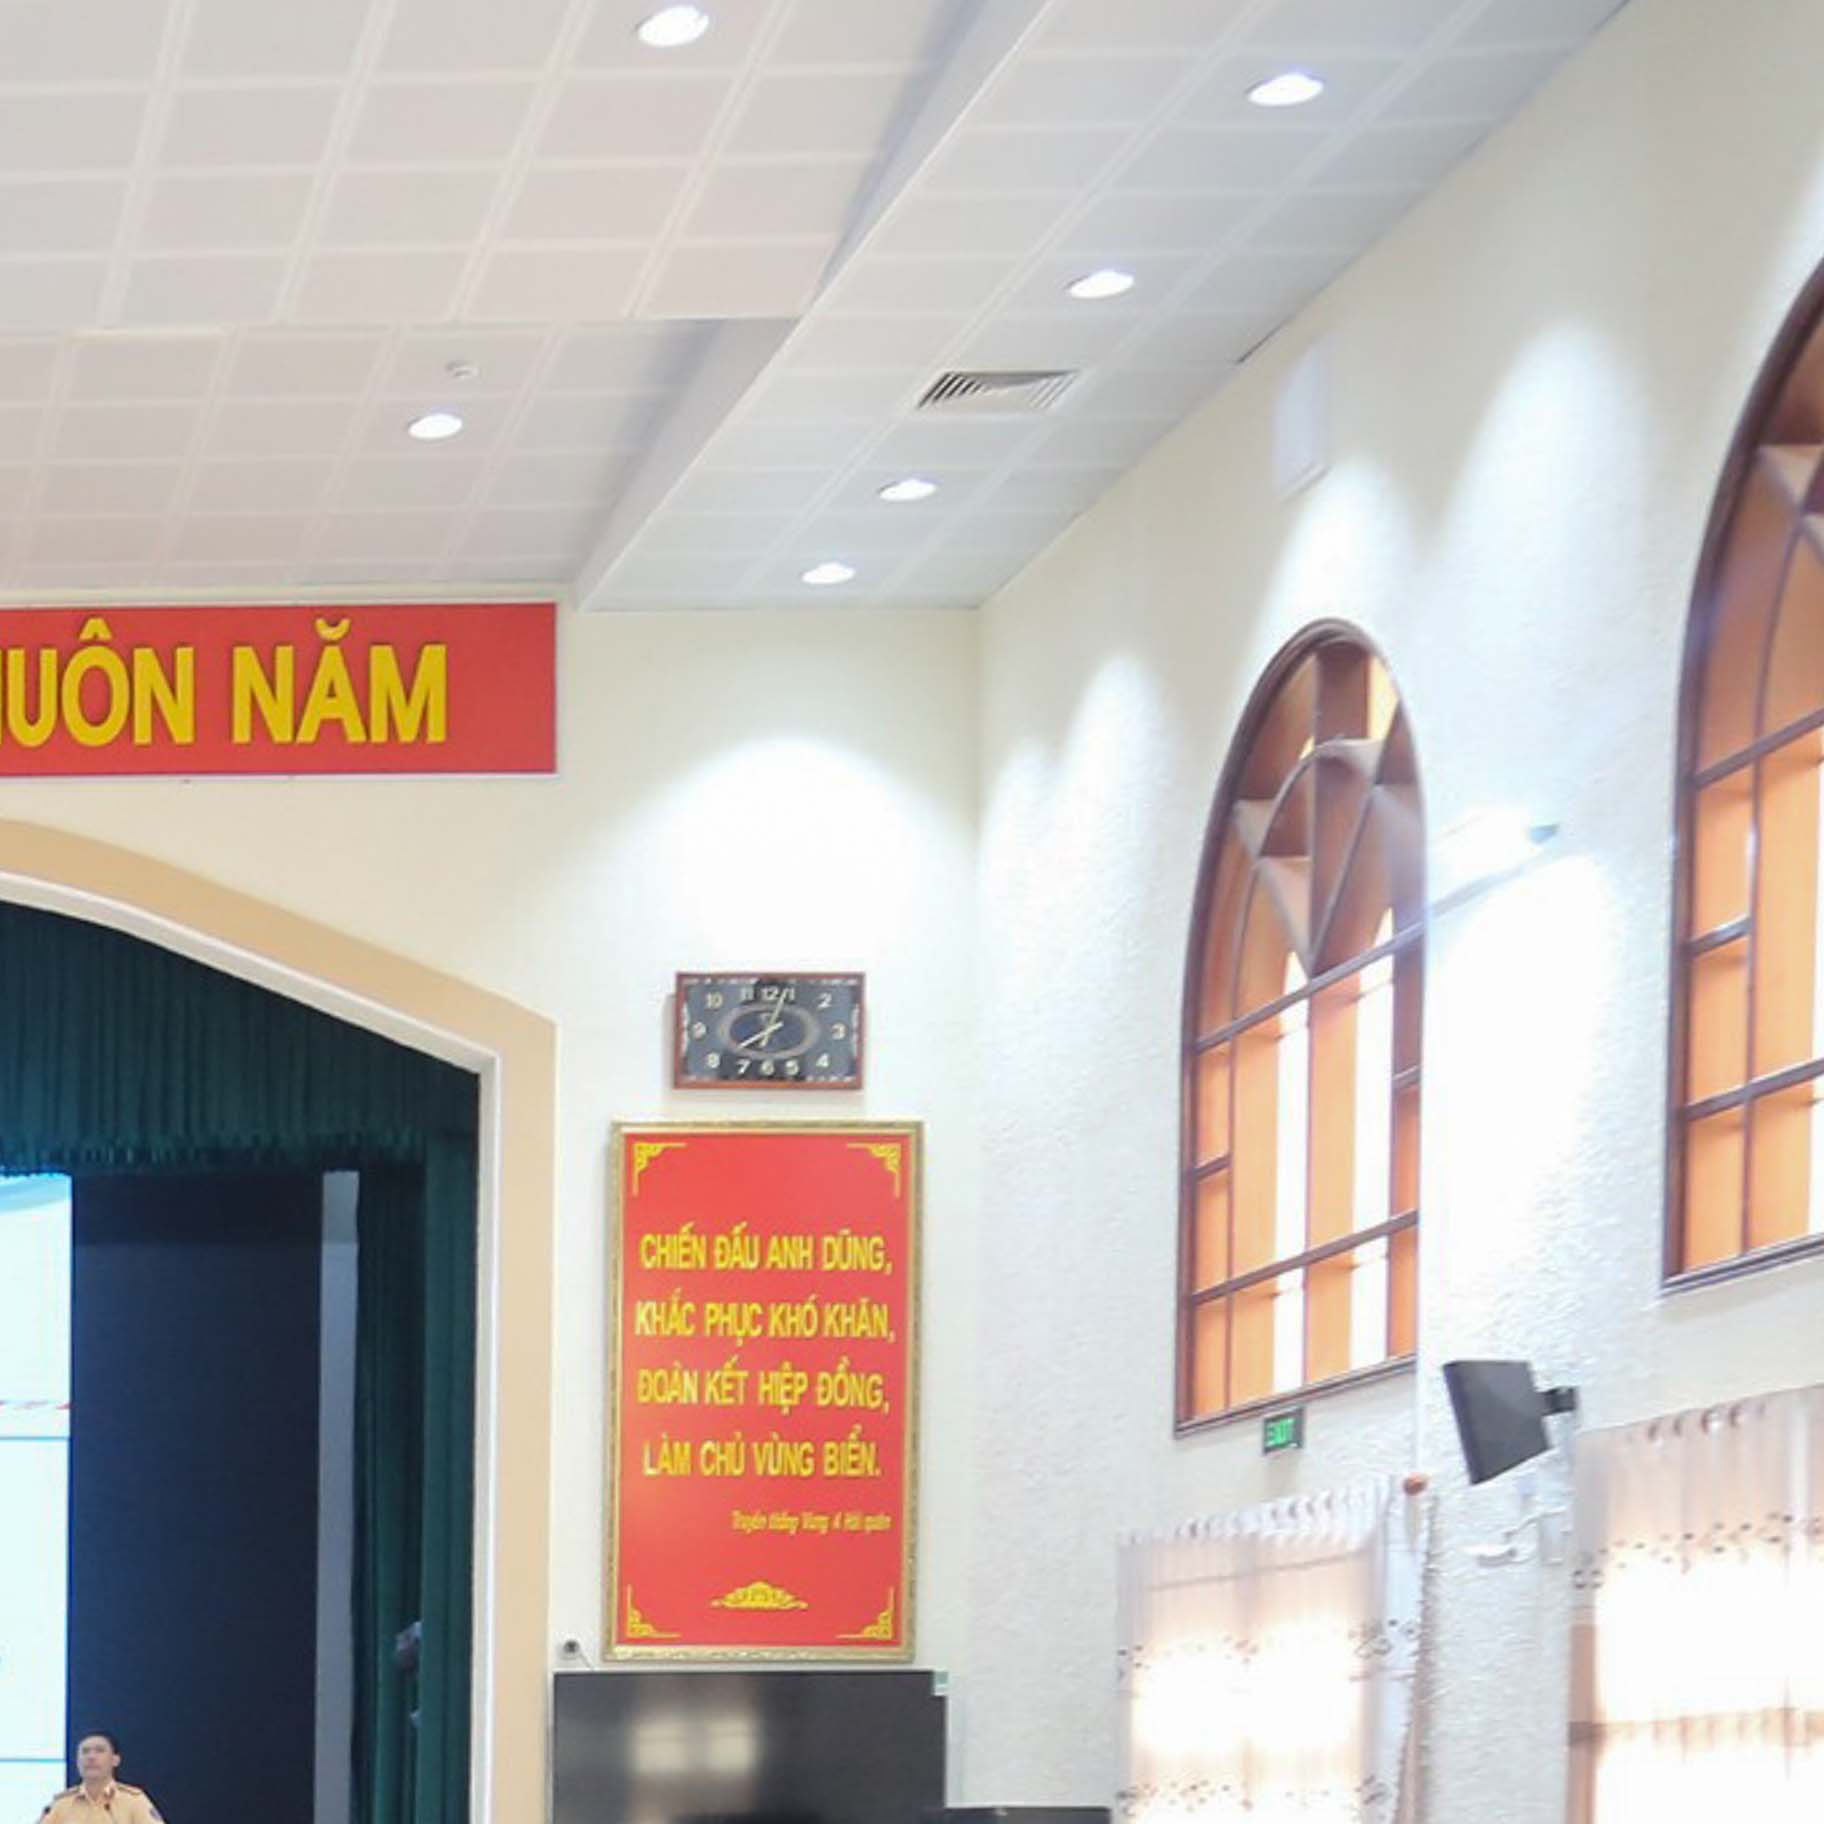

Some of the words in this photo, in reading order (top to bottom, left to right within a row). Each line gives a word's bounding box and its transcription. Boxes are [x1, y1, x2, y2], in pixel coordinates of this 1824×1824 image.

[232, 620, 448, 746] NĂM
[640, 1222, 706, 1270] CHIẾN
[714, 1221, 760, 1270] ĐẤU
[766, 1235, 813, 1269] ANH
[822, 1229, 893, 1275] DŨNG,
[635, 1288, 696, 1337] KHẮC
[704, 1301, 763, 1347] PHỤC
[769, 1294, 818, 1338] KHÓ
[824, 1297, 896, 1343] KHĂN,
[637, 1362, 698, 1405] ĐOÀN
[705, 1355, 748, 1405] KẾT
[758, 1361, 808, 1415] HIỆP
[816, 1356, 889, 1414] ĐỒNG,
[642, 1432, 690, 1476] LÀM
[700, 1431, 745, 1476] CHỦ
[753, 1432, 815, 1477] VÙNG
[823, 1424, 881, 1477] BIỂN.
